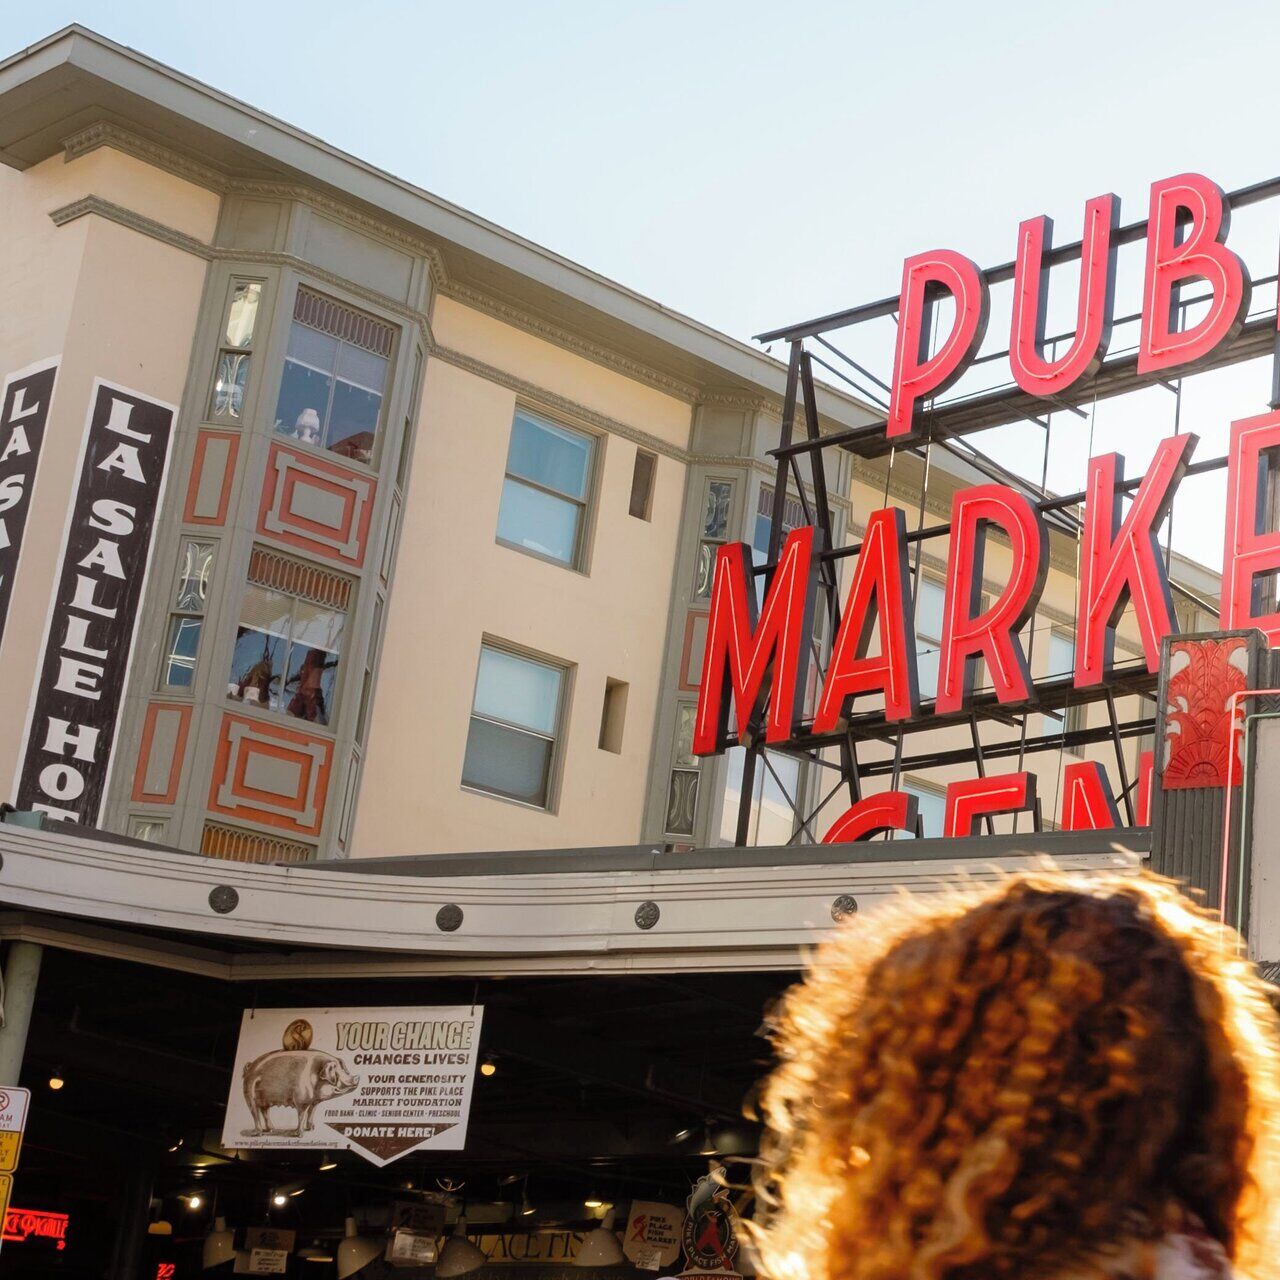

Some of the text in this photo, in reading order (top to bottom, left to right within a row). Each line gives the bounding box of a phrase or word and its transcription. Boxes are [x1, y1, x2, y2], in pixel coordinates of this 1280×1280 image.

[97, 397, 151, 484] LA
[54, 499, 137, 701] SALLE
[336, 1020, 475, 1051] YOUR CHANGE
[353, 1053, 470, 1065] CHANGES LIVES!
[367, 1075, 467, 1084] YOUR GENEROSITY
[361, 1087, 464, 1096] SUPPORTS THE PIKE PLACE
[352, 1098, 463, 1107] MARKET FOUNDATION
[402, 1110, 425, 1118] CENTER
[344, 1127, 436, 1138] DONATE HERE!
